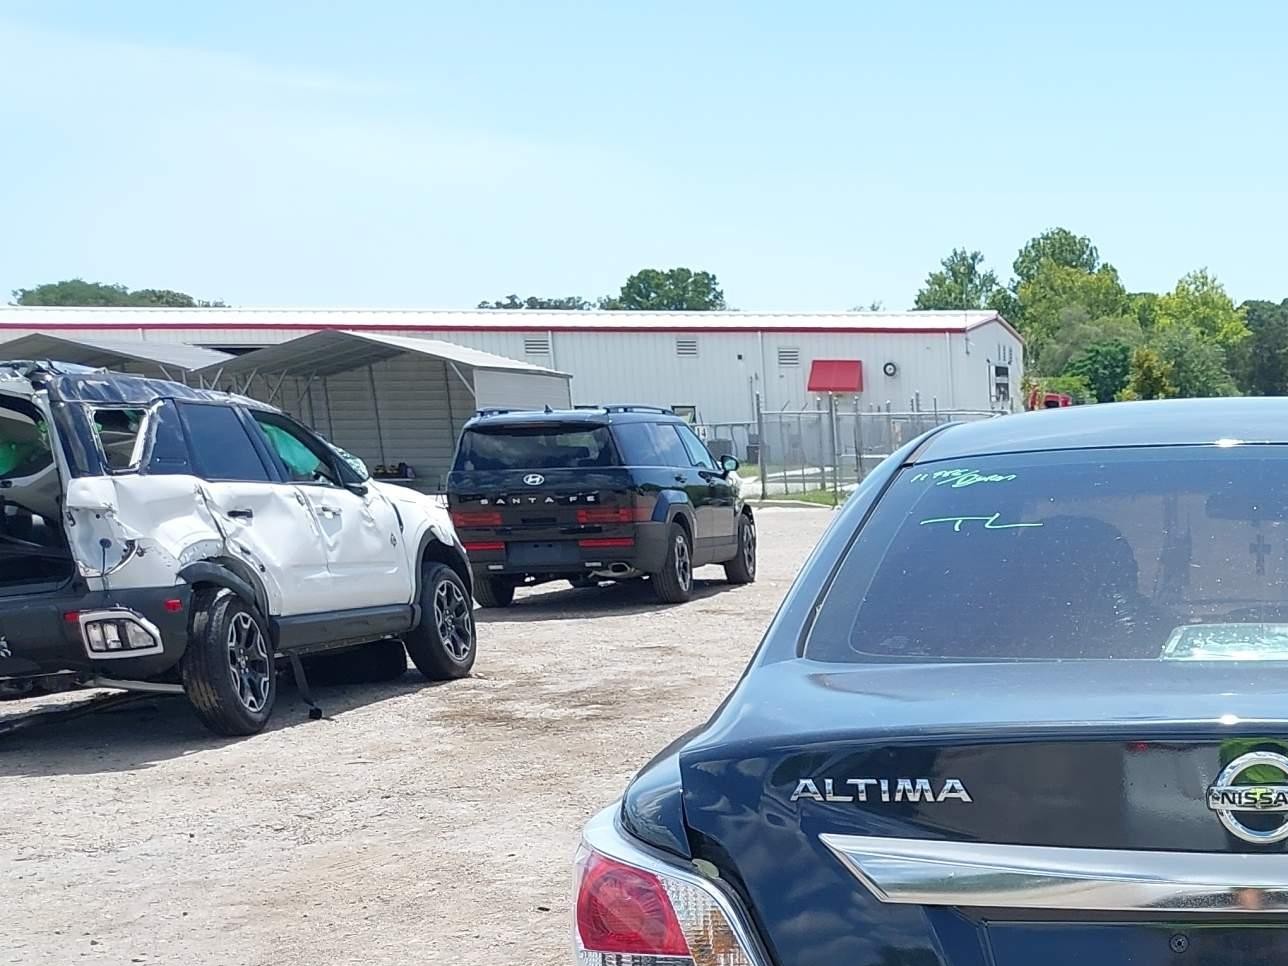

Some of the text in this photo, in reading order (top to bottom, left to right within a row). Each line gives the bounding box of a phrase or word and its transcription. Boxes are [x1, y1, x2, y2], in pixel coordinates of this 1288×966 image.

[480, 495, 596, 505] SANTA FE
[790, 778, 973, 802] ALTIMA
